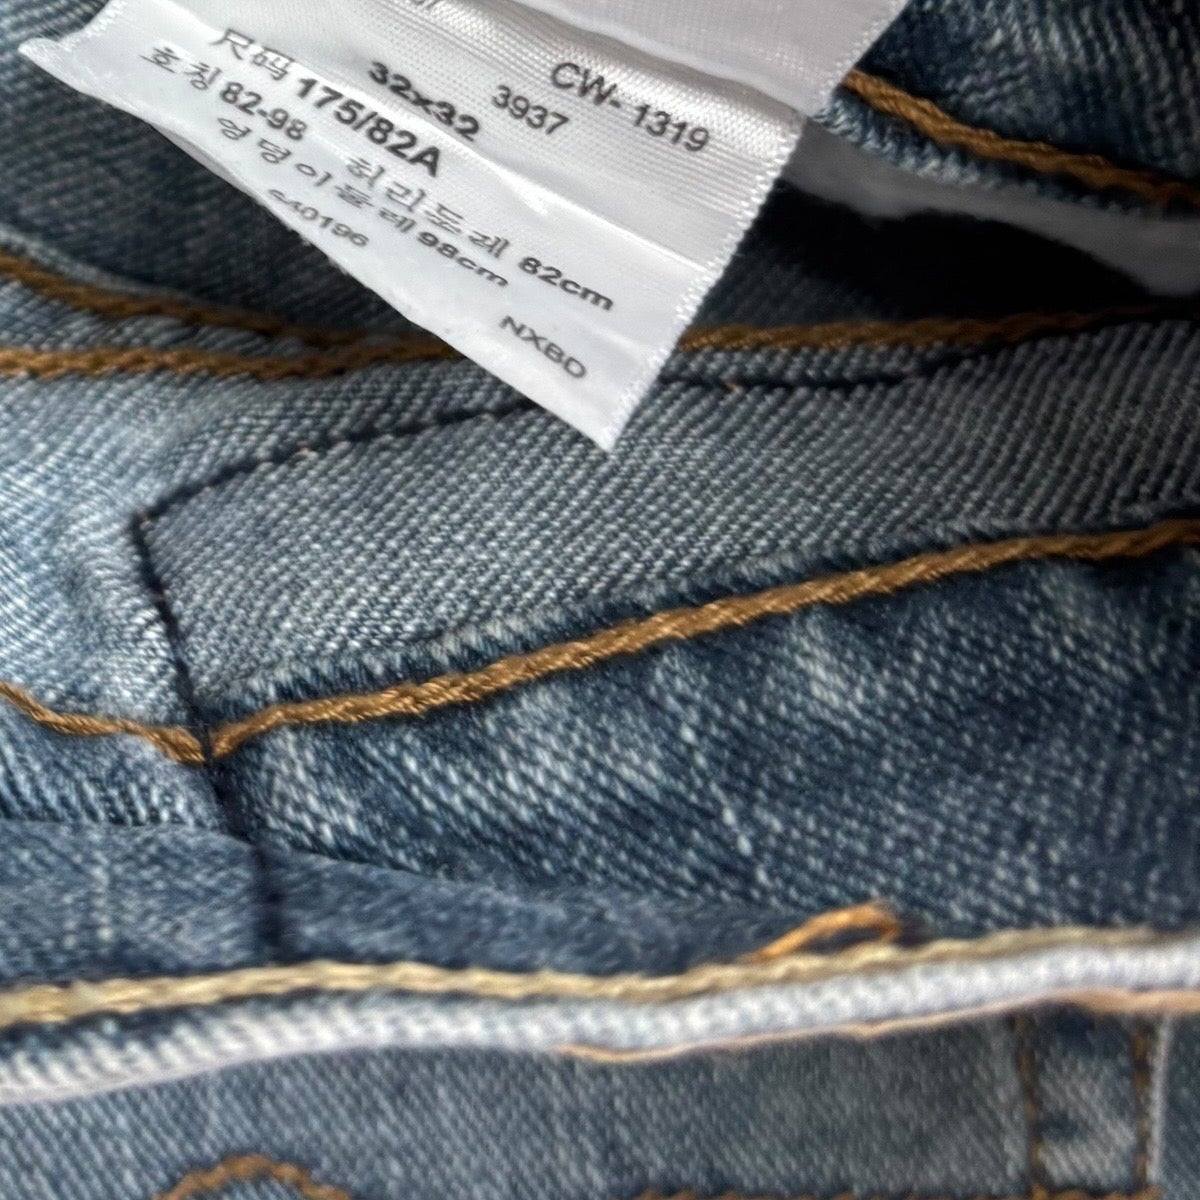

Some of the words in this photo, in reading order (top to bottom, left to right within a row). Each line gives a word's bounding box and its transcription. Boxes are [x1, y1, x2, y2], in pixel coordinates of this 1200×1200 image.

[209, 28, 296, 82] 尺码
[298, 77, 442, 178] 175/82A
[368, 59, 481, 143] 32x32
[491, 84, 570, 136] 3937
[140, 46, 222, 91] 호칭
[219, 81, 308, 141] 82-98
[517, 256, 615, 312] 82cm
[416, 230, 509, 288] 98cm
[499, 314, 587, 381] NXBD
